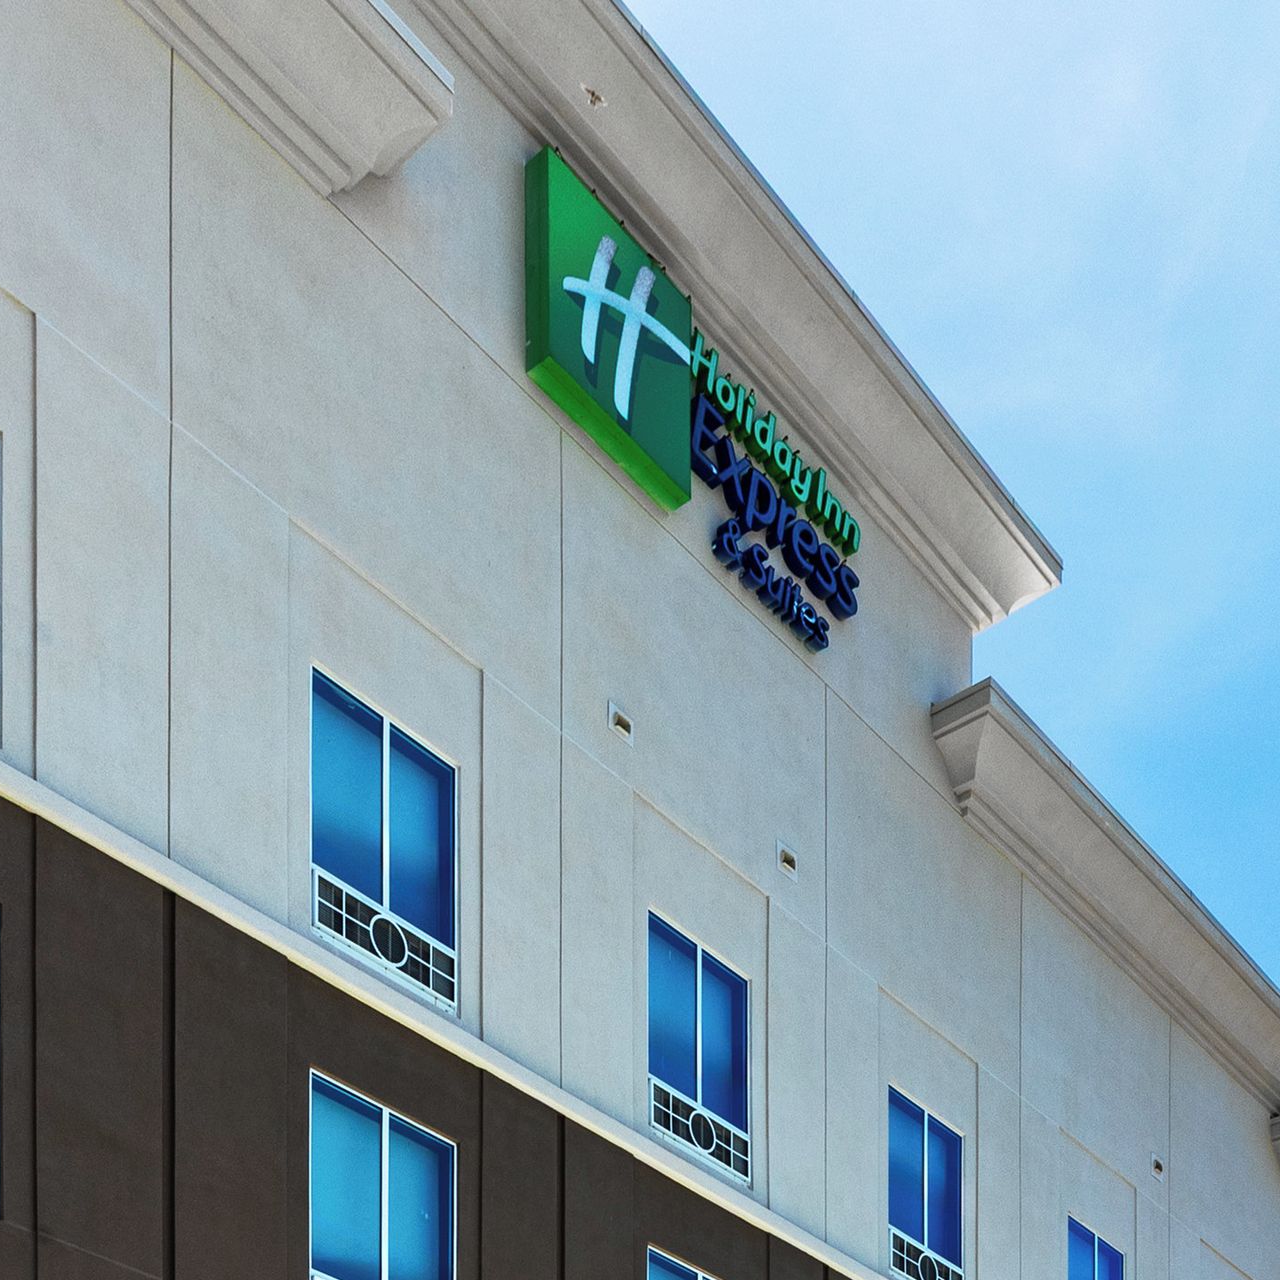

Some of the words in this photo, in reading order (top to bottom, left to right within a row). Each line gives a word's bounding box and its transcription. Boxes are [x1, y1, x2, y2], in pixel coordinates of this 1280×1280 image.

[690, 328, 814, 508] Holiday
[815, 467, 862, 557] Inn
[690, 394, 861, 621] Express
[712, 515, 744, 571] &
[738, 542, 830, 654] Suites
